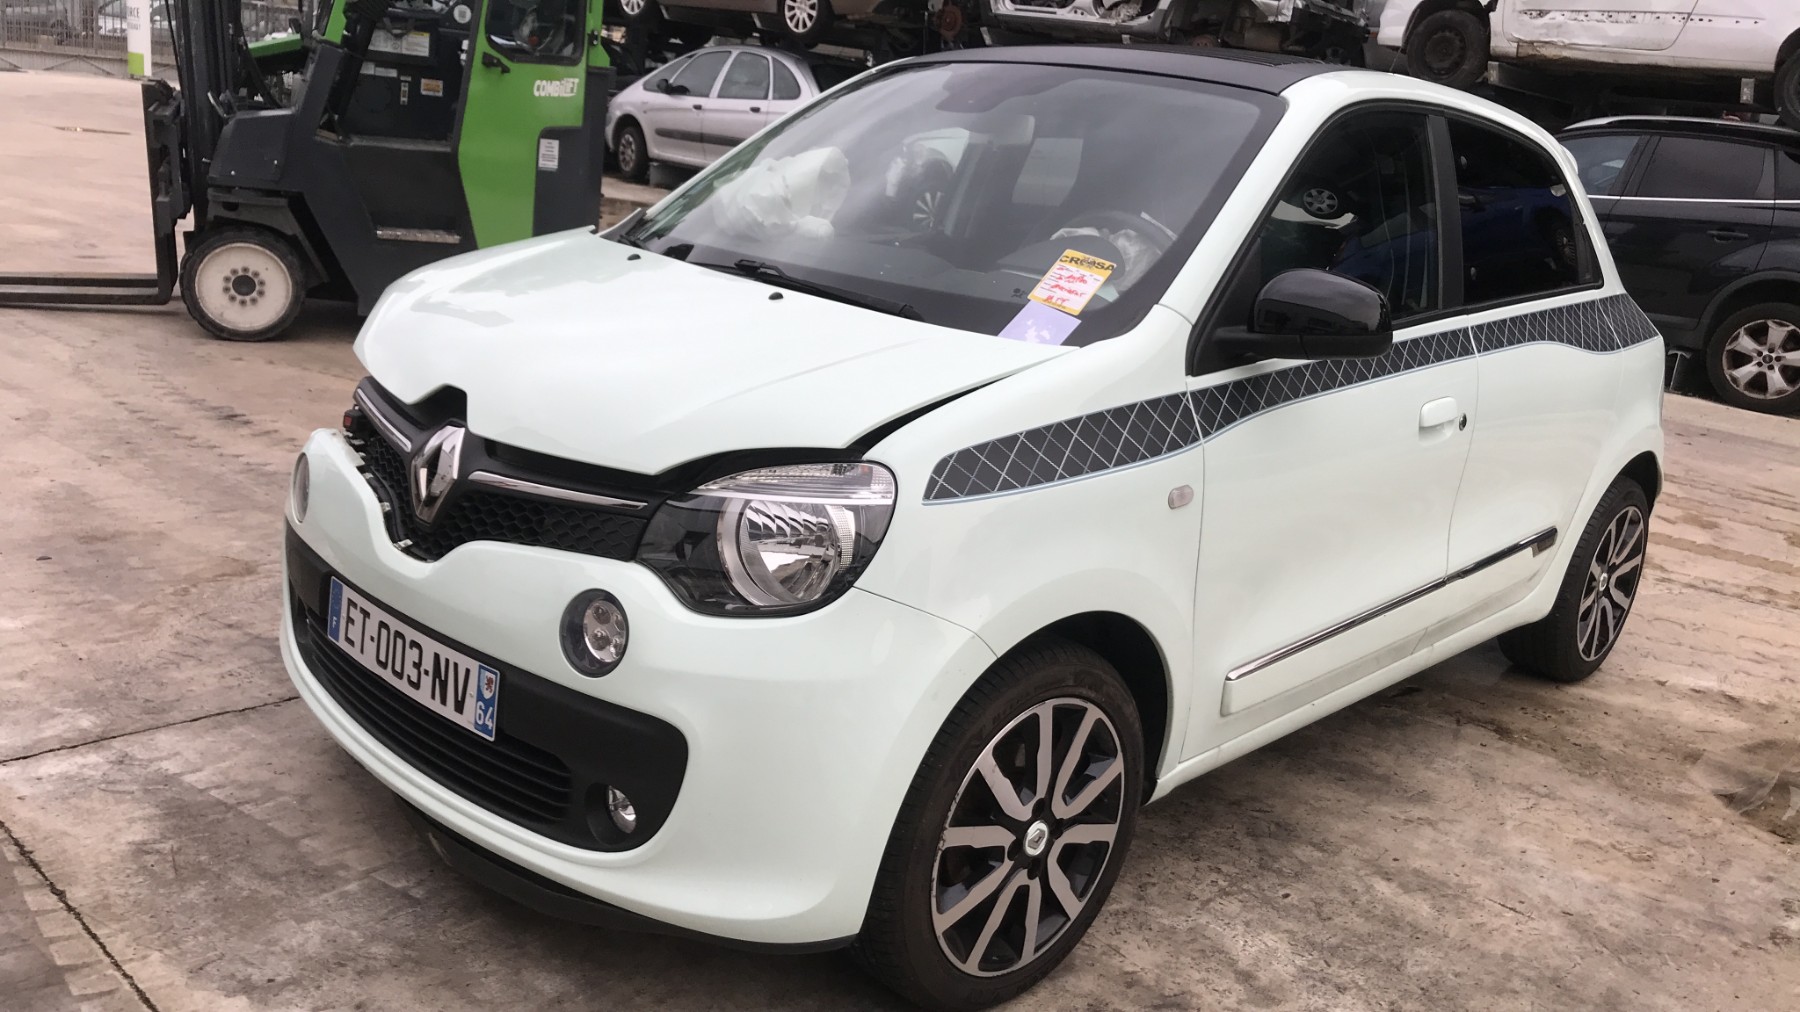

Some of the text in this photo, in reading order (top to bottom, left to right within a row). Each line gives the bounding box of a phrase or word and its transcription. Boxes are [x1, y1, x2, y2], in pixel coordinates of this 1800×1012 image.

[332, 597, 493, 731] F ET-003-NV 64
